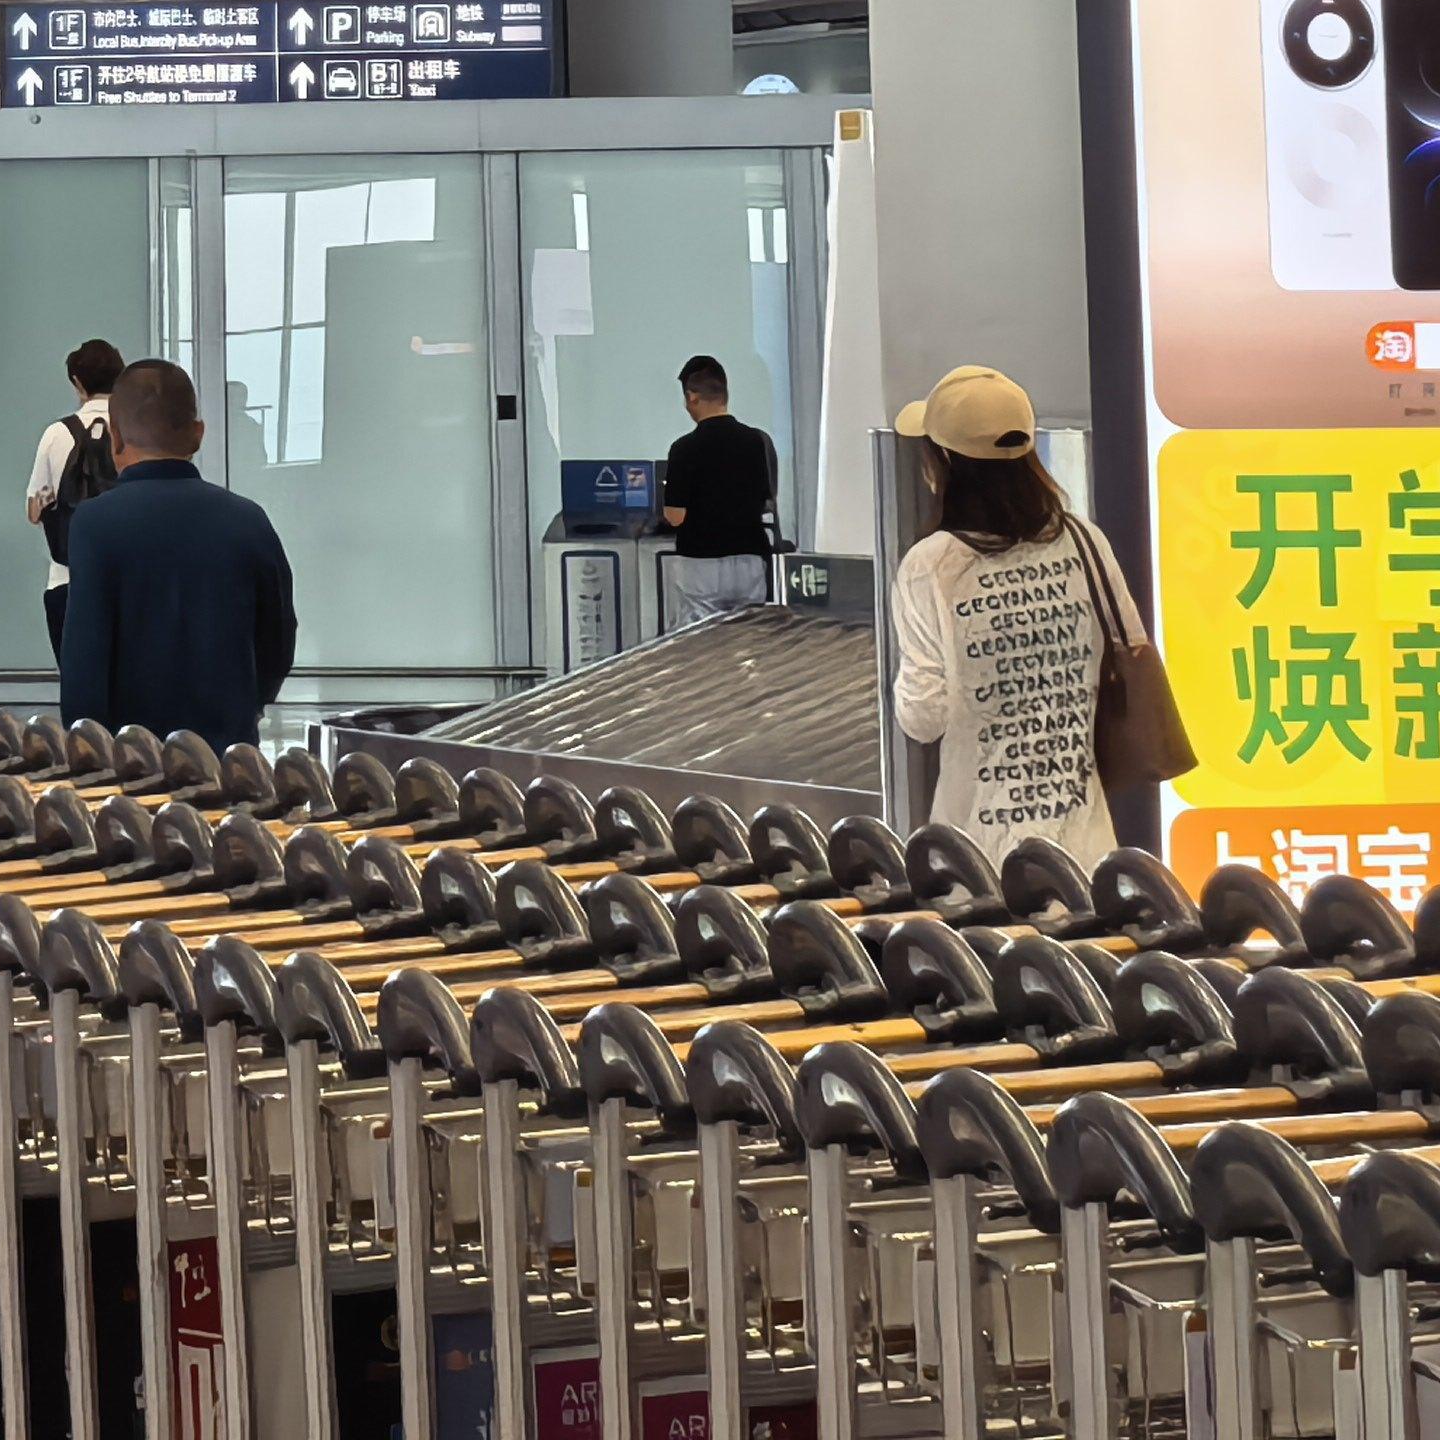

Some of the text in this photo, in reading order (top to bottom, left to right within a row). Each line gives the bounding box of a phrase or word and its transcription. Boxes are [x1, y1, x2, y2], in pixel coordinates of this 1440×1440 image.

[55, 13, 79, 32] 1F
[408, 58, 461, 80] 出租车
[1374, 330, 1412, 362] 淘
